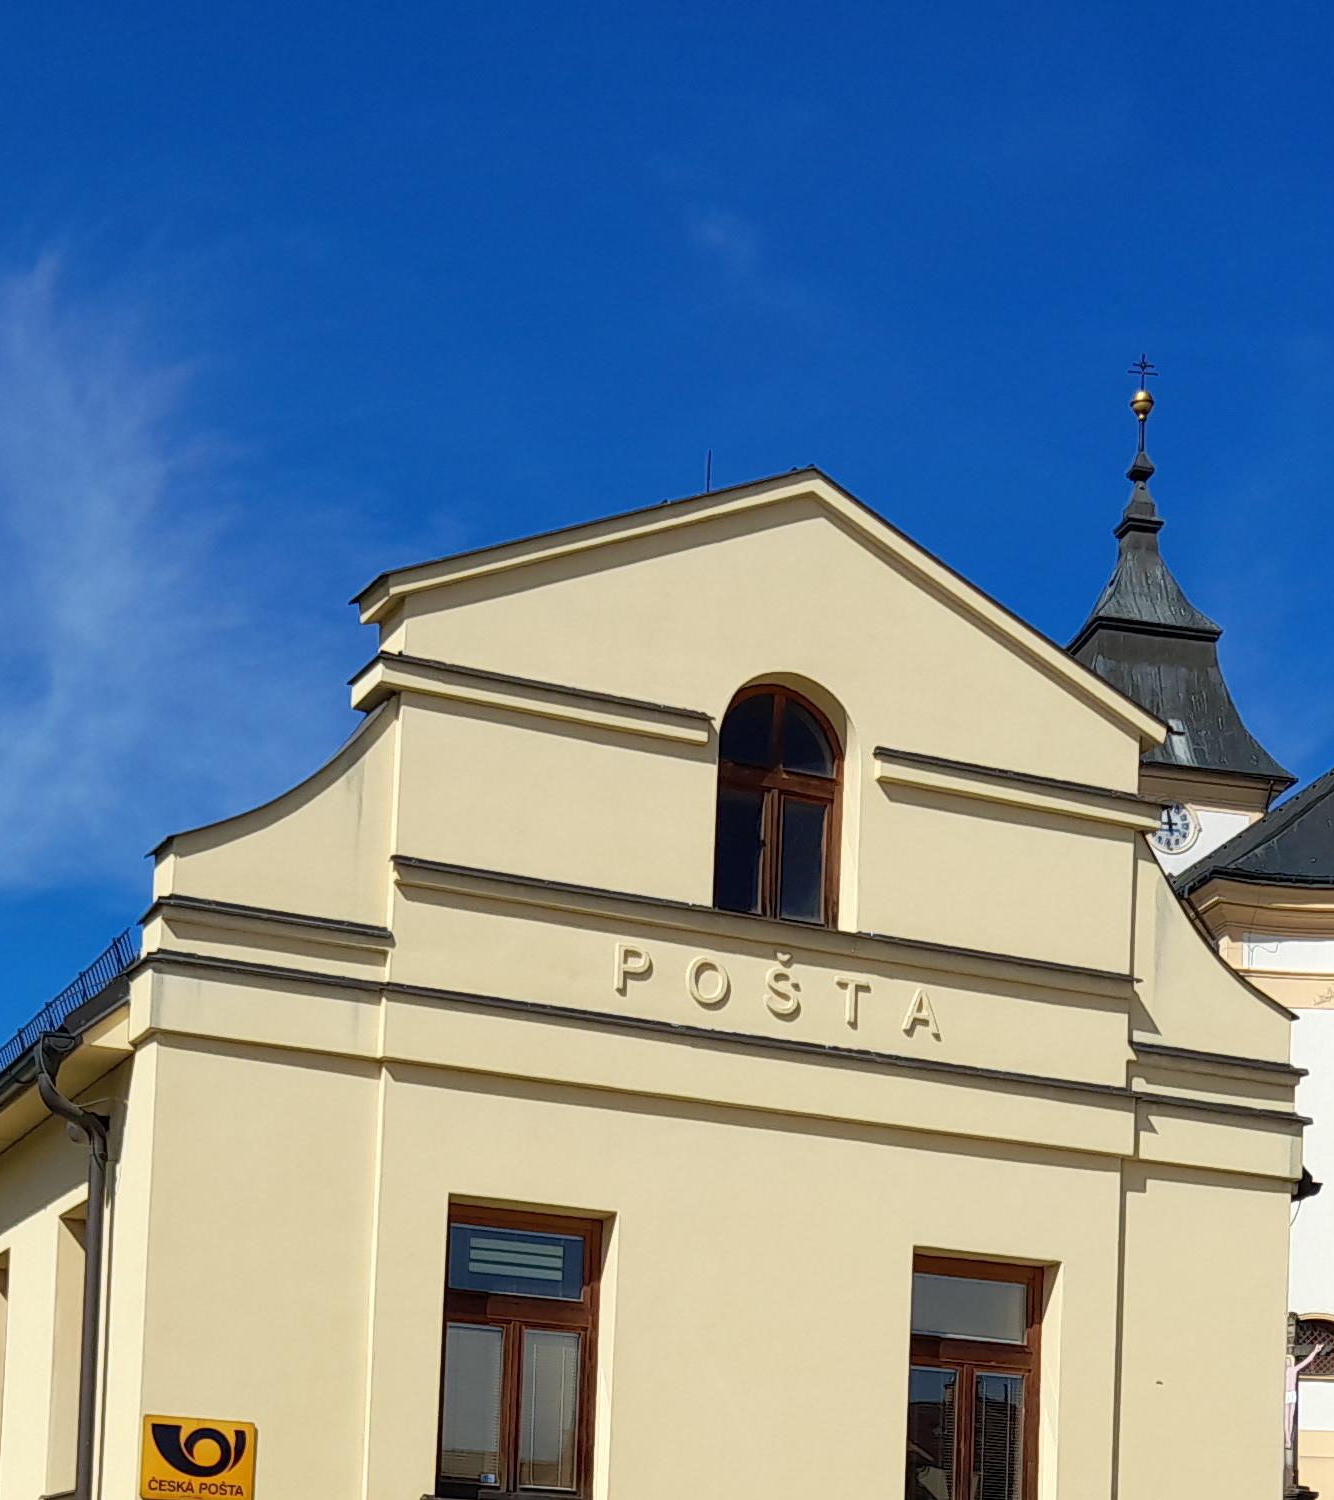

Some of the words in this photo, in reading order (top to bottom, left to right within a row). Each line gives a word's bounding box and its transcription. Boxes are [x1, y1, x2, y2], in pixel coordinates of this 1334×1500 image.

[613, 942, 942, 1042] POŠTA
[147, 1476, 194, 1493] ČESKÁ
[199, 1481, 244, 1496] POŠTA
